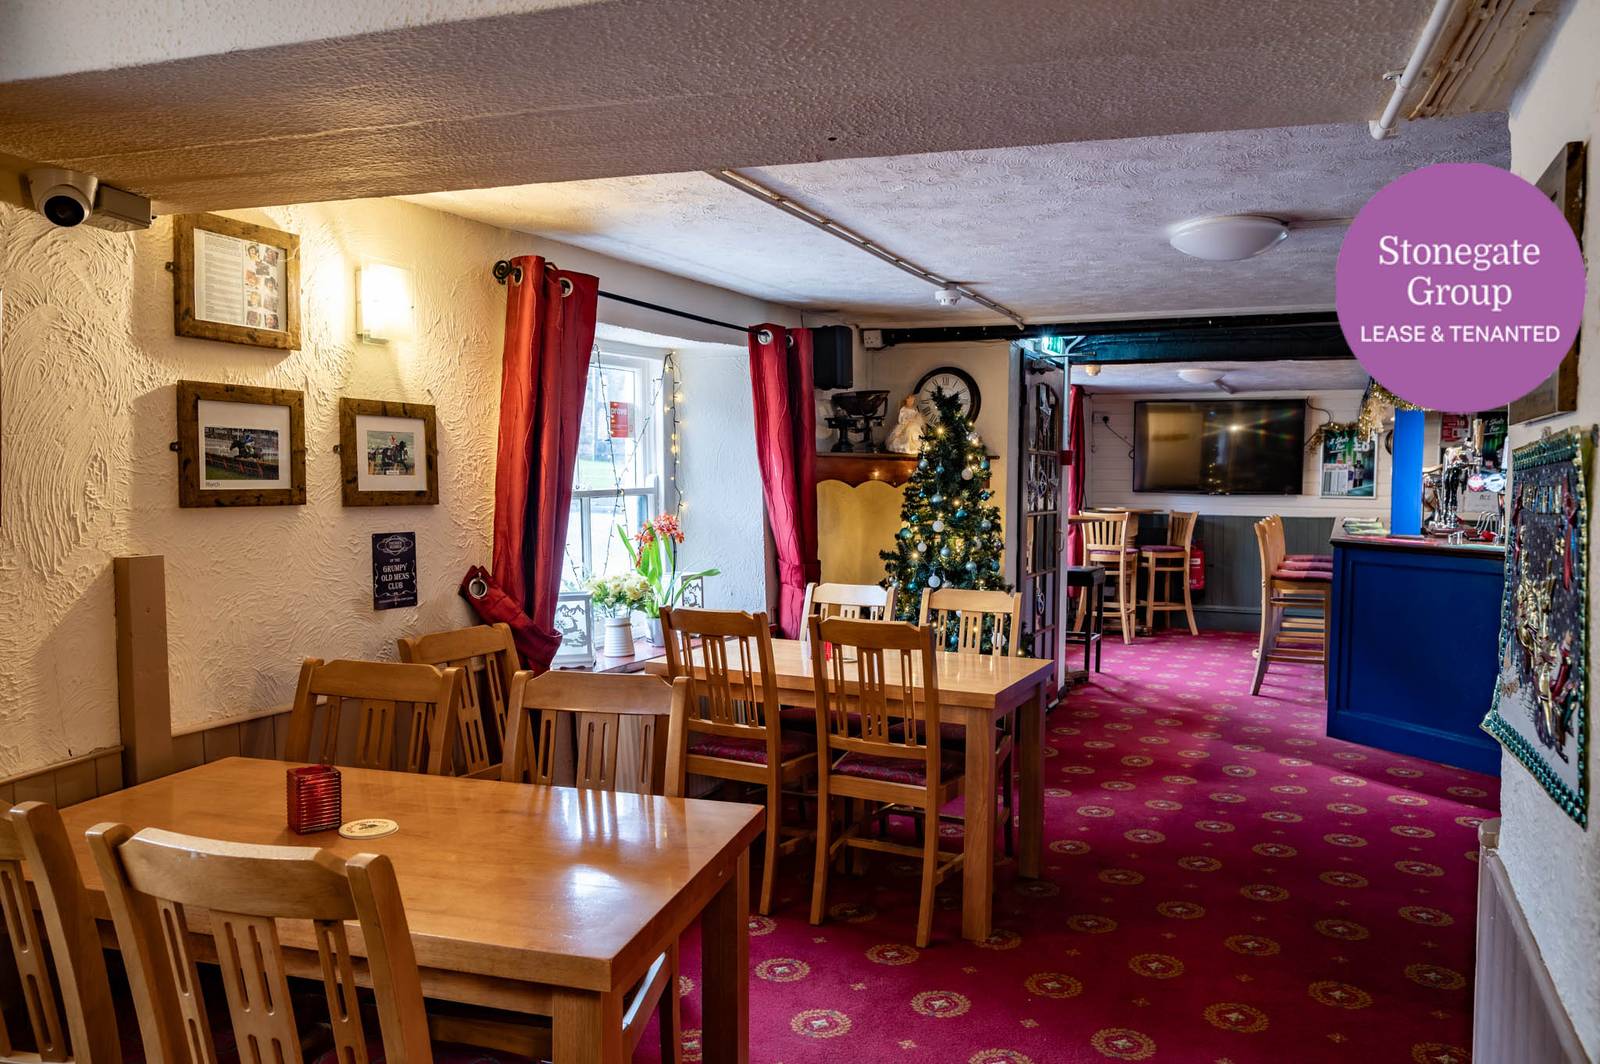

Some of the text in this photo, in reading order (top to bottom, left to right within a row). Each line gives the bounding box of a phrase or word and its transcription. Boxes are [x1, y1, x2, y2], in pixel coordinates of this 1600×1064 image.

[383, 563, 408, 573] GRUMPY
[381, 572, 410, 582] OLD MENS
[388, 582, 404, 590] CLUB
